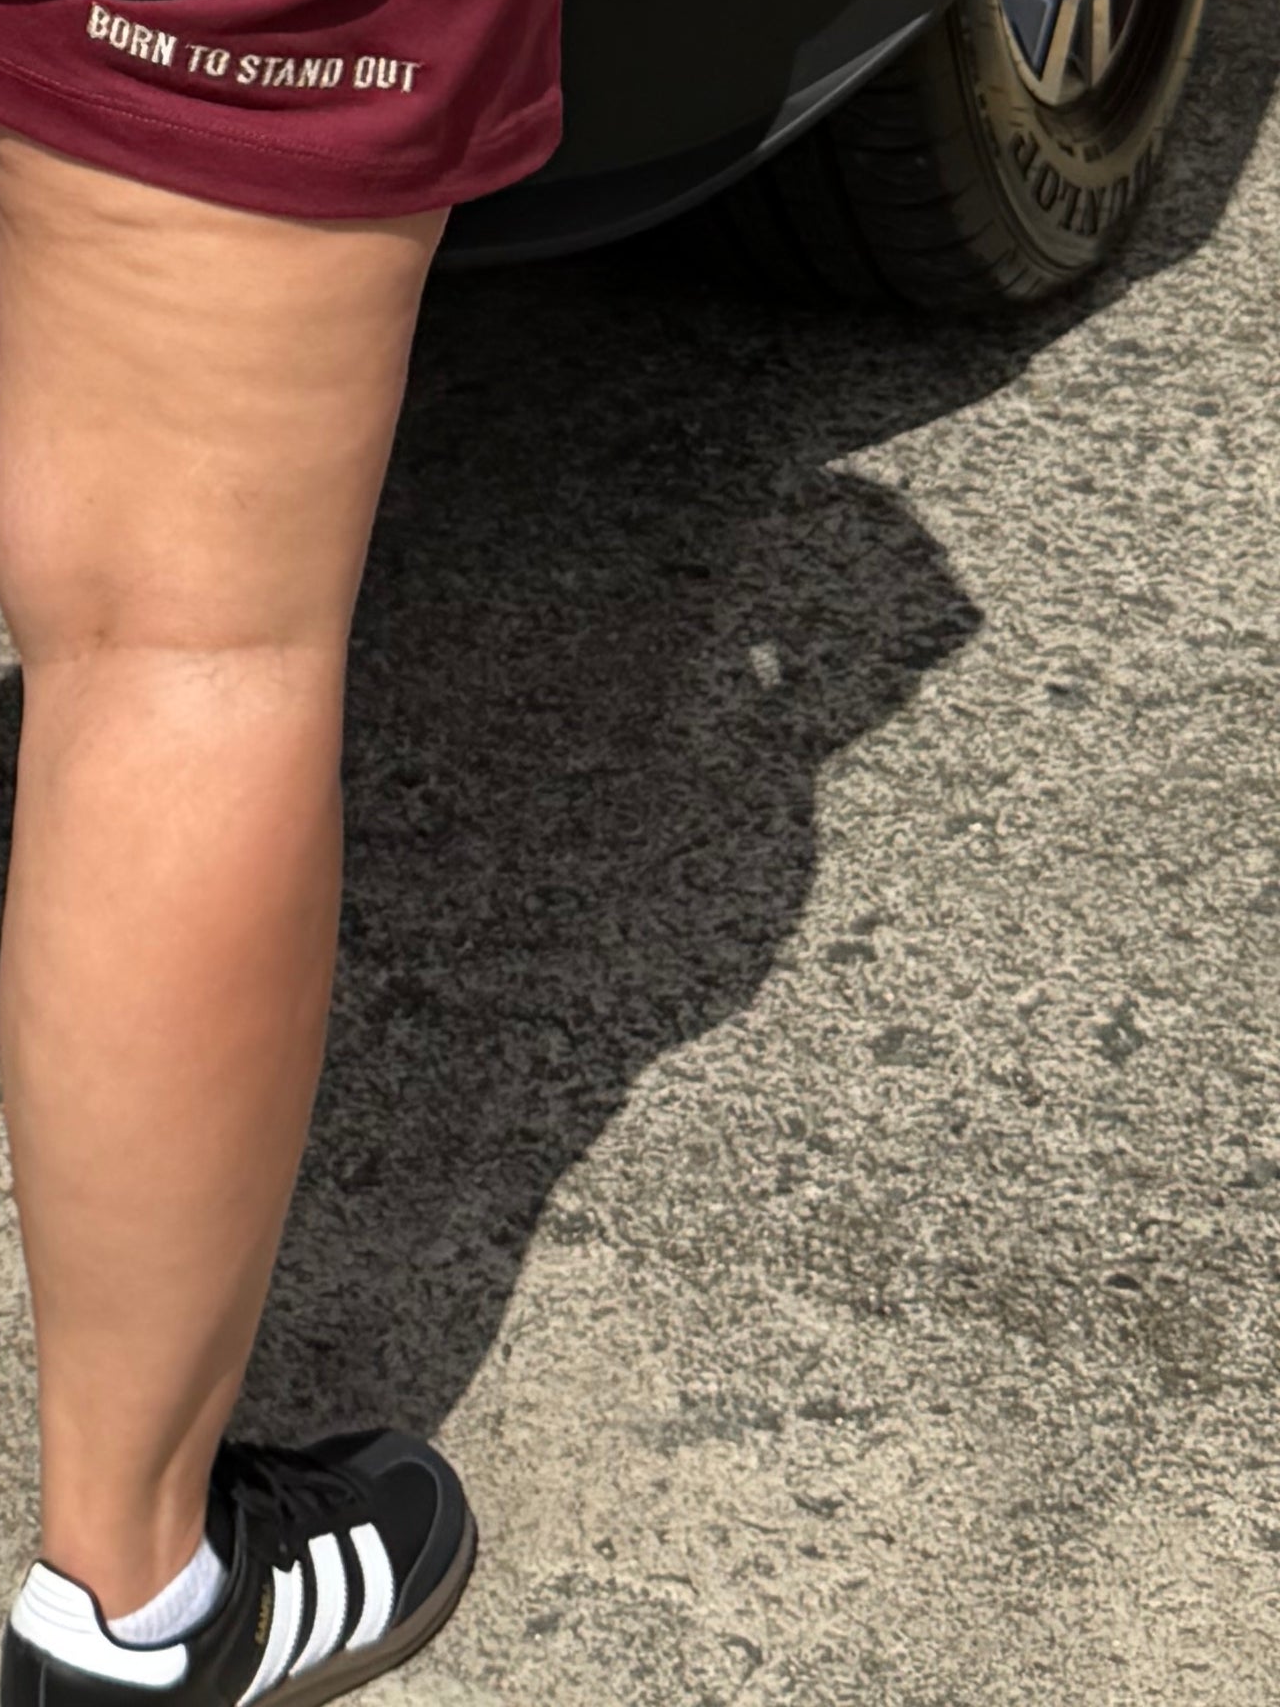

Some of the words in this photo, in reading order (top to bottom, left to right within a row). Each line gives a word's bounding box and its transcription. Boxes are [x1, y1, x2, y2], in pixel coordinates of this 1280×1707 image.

[86, 0, 178, 68] BORN
[185, 43, 231, 77] TO
[236, 53, 344, 89] STAND
[351, 55, 424, 94] OUT
